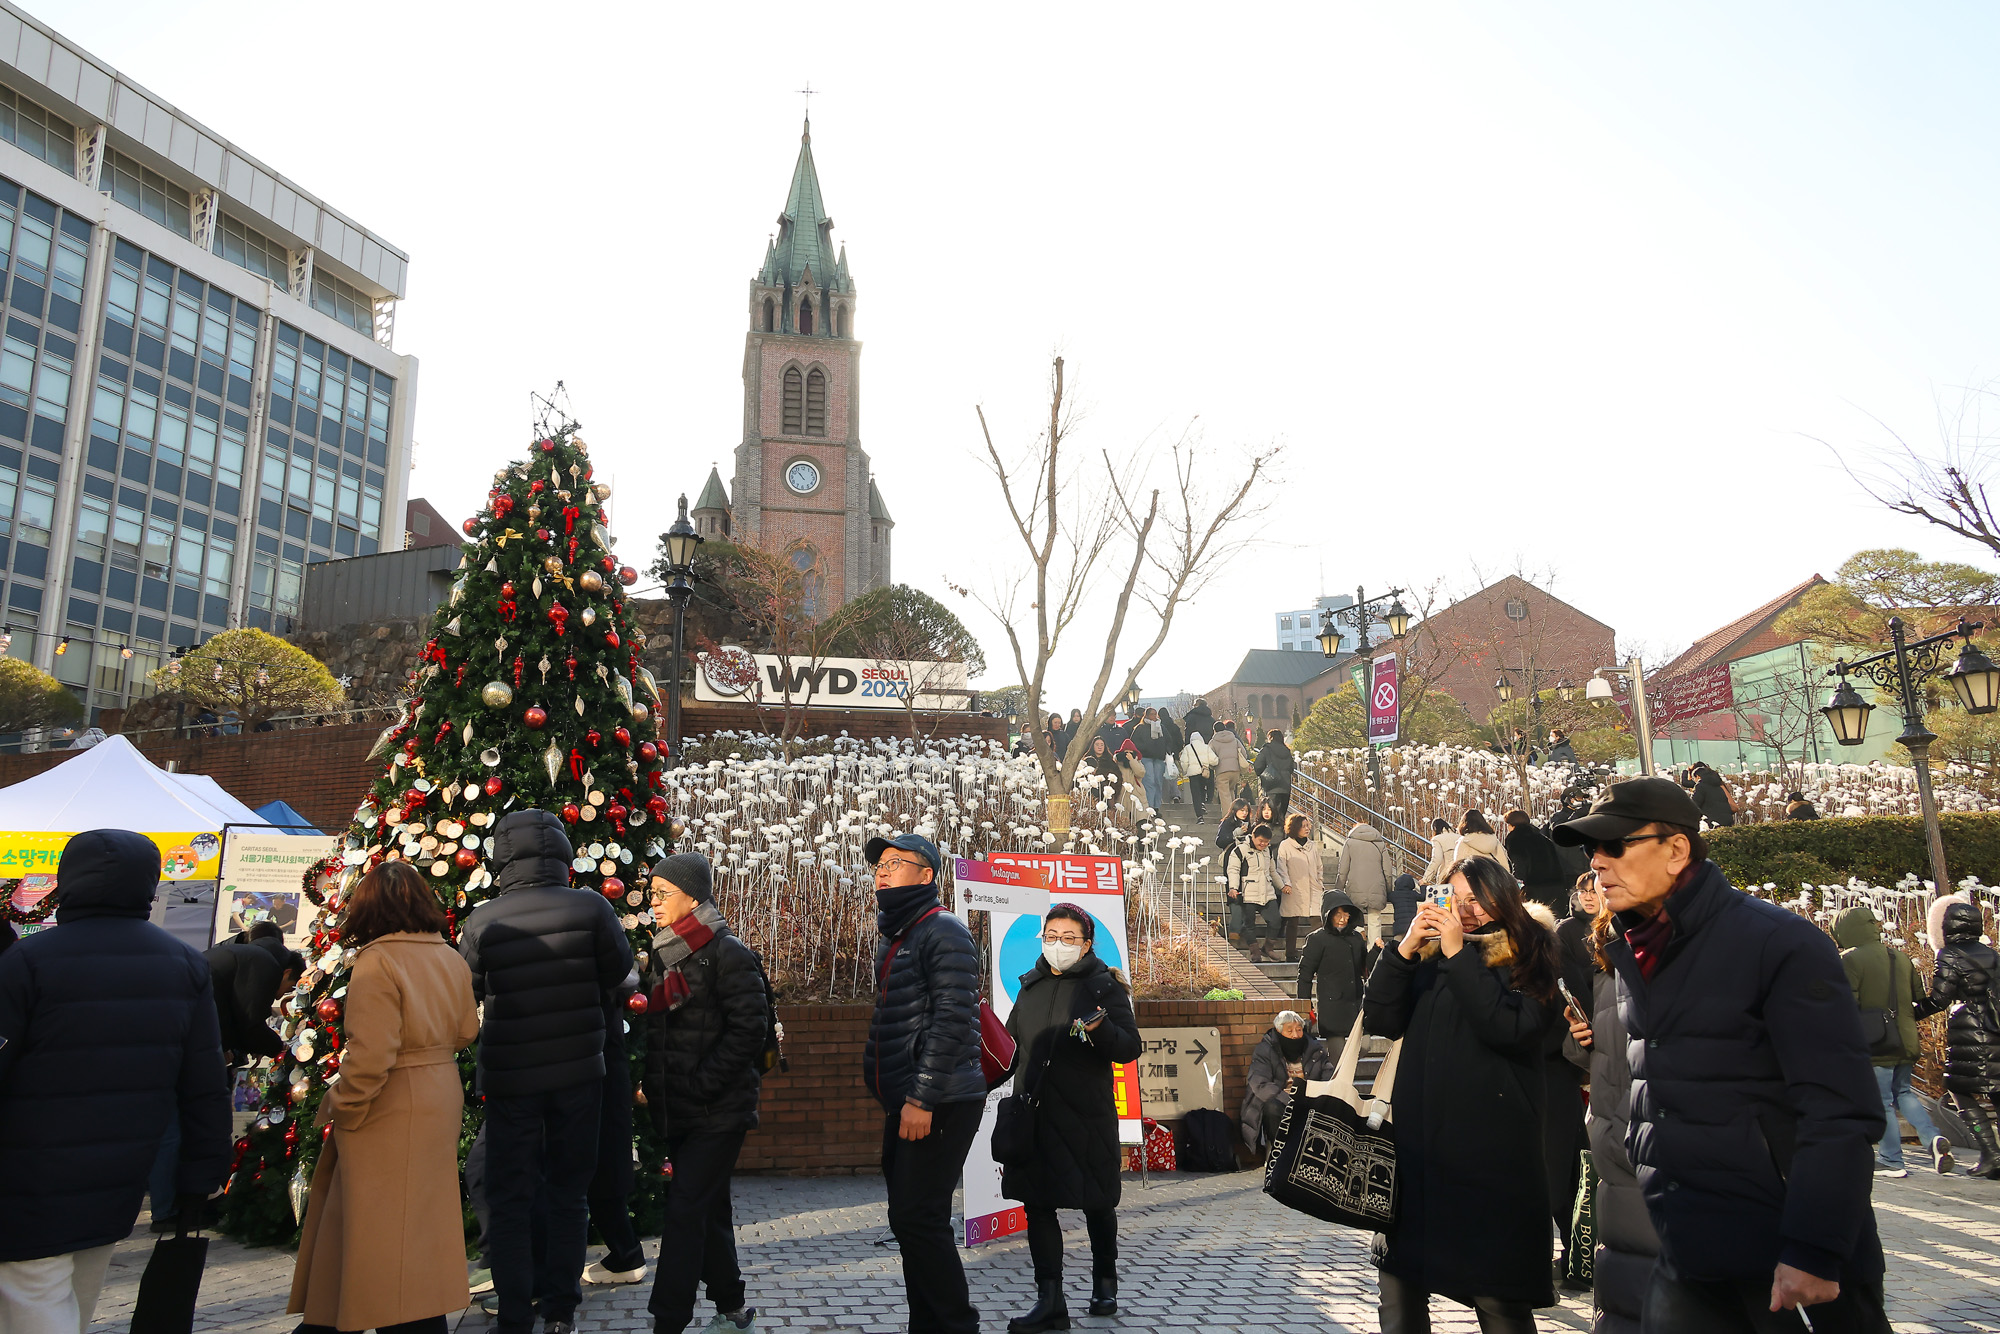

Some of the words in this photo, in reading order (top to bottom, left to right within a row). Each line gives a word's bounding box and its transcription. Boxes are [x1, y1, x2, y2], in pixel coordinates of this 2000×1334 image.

[766, 665, 857, 695] WYD
[861, 668, 909, 681] SEOUL
[861, 680, 909, 697] 2027
[990, 865, 1020, 883] Instagram
[1095, 862, 1119, 890] 길
[974, 894, 1009, 905] Caritas_Seoul
[1278, 1085, 1298, 1135] DAUNT
[1355, 1143, 1375, 1153] OOKS
[1580, 1224, 1592, 1279] BOOKS
